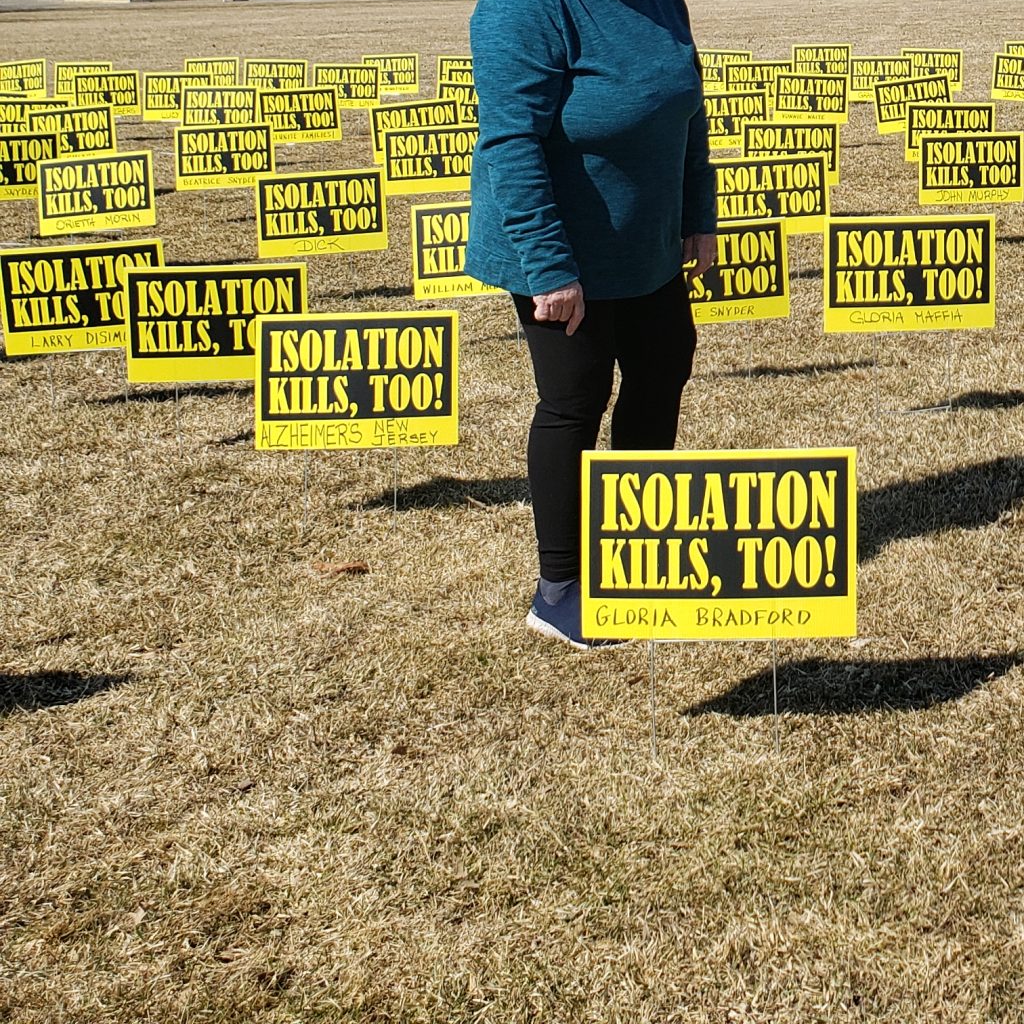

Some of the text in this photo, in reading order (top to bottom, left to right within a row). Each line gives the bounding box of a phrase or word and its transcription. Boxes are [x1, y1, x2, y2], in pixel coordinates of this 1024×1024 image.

[796, 48, 847, 62] ISOLATION
[248, 64, 303, 78] ISOLATION
[317, 68, 376, 84] ISOLATION
[825, 61, 847, 73] TOO!
[853, 61, 910, 76] ISOLATION
[24, 78, 42, 89] TOO!
[77, 76, 134, 92] ISOLATION
[350, 84, 376, 98] TOO!
[780, 77, 844, 96] ISOLATION
[878, 79, 947, 105] ISOLATION
[111, 92, 135, 105] TOO!
[147, 94, 179, 109] KILLS,
[186, 91, 254, 109] ISOLATION
[262, 93, 333, 113] ISOLATION
[778, 95, 843, 112] KILLS, TOO!
[32, 111, 108, 133] ISOLATION
[185, 108, 253, 125] KILLS, TOO!
[303, 112, 335, 128] TOO!
[376, 104, 454, 130] ISOLATION
[912, 109, 989, 129] ISOLATION
[76, 131, 110, 149] TOO!
[181, 130, 267, 154] ISOLATION
[390, 132, 478, 157] ISOLATION
[748, 128, 833, 149] ISOLATION
[181, 152, 268, 174] KILLS, TOO!
[926, 140, 1017, 165] ISOLATION
[44, 159, 144, 192] ISOLATION
[390, 157, 437, 178] KILLS,
[716, 162, 820, 193] ISOLATION
[926, 164, 1017, 188] KILLS, TOO!
[183, 177, 221, 186] BEATRICE
[45, 185, 146, 215] KILLS, TOO!
[264, 178, 376, 211] ISOLATION
[717, 190, 821, 218] KILLS, TOO!
[936, 189, 1010, 202] JOHN MURPHY
[105, 214, 141, 225] MORIN
[265, 206, 378, 236] KILLS, TOO!
[294, 238, 345, 252] DICK
[836, 228, 984, 267] ISOLATION
[423, 282, 473, 294] WILLIAM
[720, 265, 777, 296] TOO!
[835, 267, 983, 305] KILLS, TOO!
[136, 277, 294, 317] ISOLATION
[12, 294, 89, 327] KILLS,
[710, 305, 755, 317] SNYDER
[850, 309, 963, 324] GLORIA MAFFIA
[31, 334, 73, 348] LARRY
[137, 320, 220, 355] KILLS,
[269, 326, 445, 372] ISOLATION
[268, 373, 444, 418] KILLS, TOO!
[261, 418, 408, 448] ALZHEIMER'S NEW
[371, 431, 438, 446] JERSEY
[601, 470, 837, 532] ISOLATION
[600, 535, 836, 596] KILLS, TOO!
[596, 605, 811, 627] GLORIA BRADFORD
